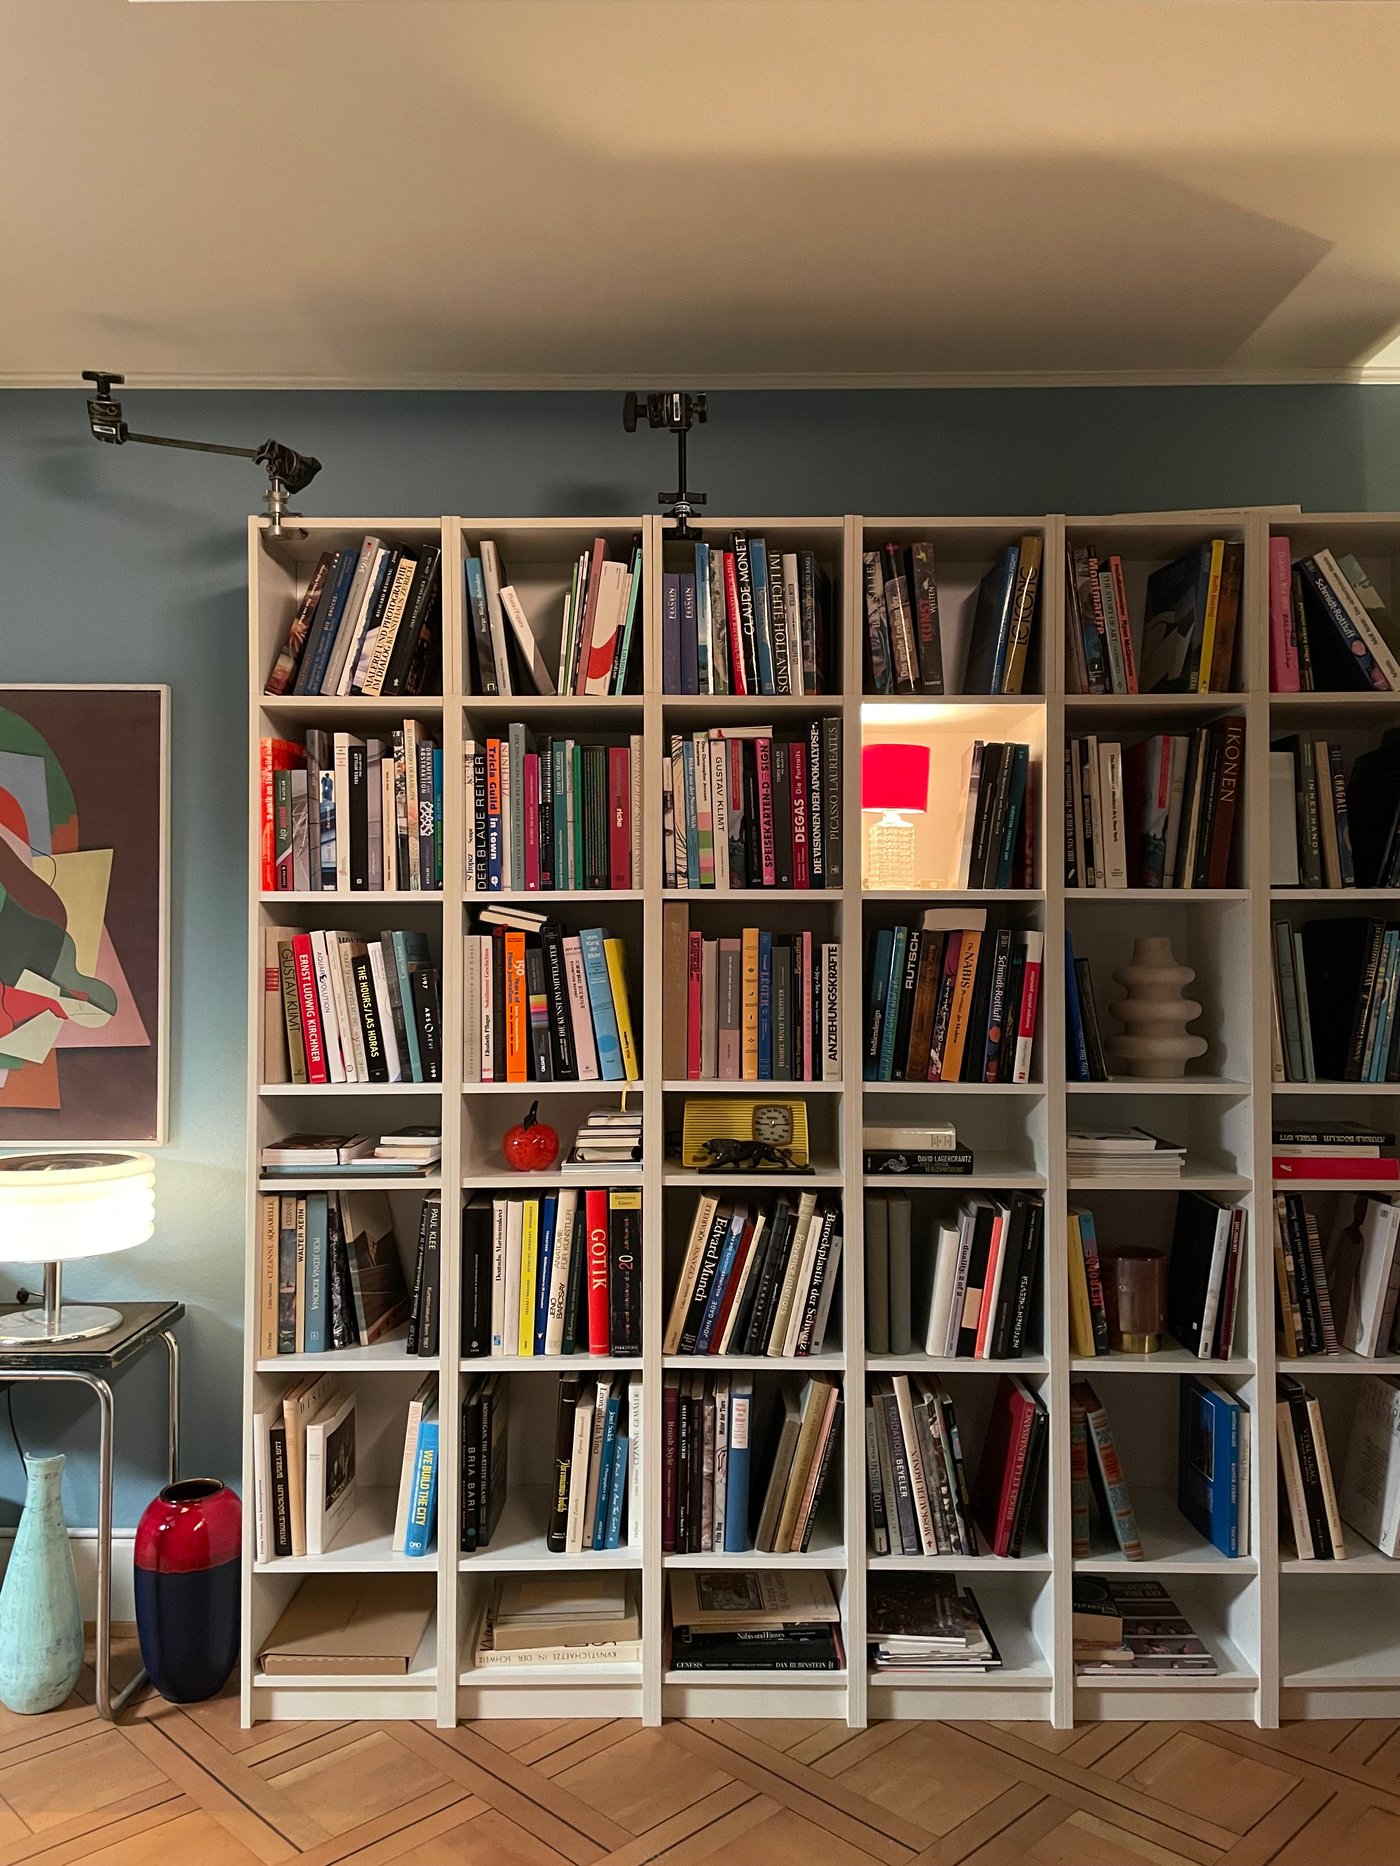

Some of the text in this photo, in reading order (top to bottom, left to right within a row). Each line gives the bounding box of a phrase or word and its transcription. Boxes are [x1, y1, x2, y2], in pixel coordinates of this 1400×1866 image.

[735, 536, 754, 635] CLAUDE MONET
[891, 595, 900, 608] der
[928, 586, 936, 613] WELTEN
[1088, 558, 1106, 634] Montmartre
[1103, 576, 1118, 642] THE STORY OF ART
[1208, 575, 1219, 618] Keith Haring
[1315, 578, 1355, 638] Schmidt-Rottluff
[365, 564, 407, 688] MALEREI UND PHOTOGRAPHIE
[384, 598, 404, 645] KUNSTHAUS
[770, 554, 788, 693] IM LICHTE HOLLANDS
[893, 609, 904, 638] Lexikon
[920, 599, 932, 641] KUNST
[372, 678, 383, 690] IM
[375, 646, 392, 677] DIALOG
[898, 663, 908, 676] Das
[488, 747, 496, 778] Tricia
[501, 745, 509, 797] ZEICHNEN
[828, 727, 839, 840] PICASSO LAUREATUS
[1220, 727, 1241, 803] IKONEN
[489, 782, 497, 810] Guild
[811, 729, 822, 874] DIE VISIONEN DER APOKALYPSE
[1334, 774, 1347, 814] CHAGALL
[475, 756, 487, 889] DER BLAUE REITER
[491, 818, 498, 827] in
[794, 799, 805, 843] DEGAS
[512, 960, 525, 976] 150
[794, 936, 802, 974] Beauties
[905, 932, 919, 989] RUTSCH
[960, 951, 975, 988] NABIS
[282, 948, 300, 1032] GUSTAV KLIMT
[299, 954, 320, 1062] ERNST LUDWIG KIRCHNER
[357, 965, 368, 981] THE
[366, 1030, 379, 1058] HORAS
[549, 944, 566, 1037] DIE KUNST IM MITTELALTER
[827, 946, 838, 1061] ANZIEHUNGSKRÄFTE
[993, 955, 1007, 1022] Schmidt-Rottluff
[870, 1009, 882, 1056] Mediendesign
[313, 1237, 321, 1252] POD
[428, 1208, 438, 1250] PAUL KLEE
[554, 1229, 562, 1269] ANATOMIE
[687, 1203, 712, 1279] CEZANNE AQUARELLE
[591, 1228, 606, 1291] GOTIK
[694, 1217, 728, 1302] Edvard Munch
[789, 1233, 805, 1275] Provence
[424, 1287, 432, 1322] Kunstmuseum
[557, 1282, 565, 1319] BARCSAY
[751, 1274, 770, 1338] EDY BRUNNER
[799, 1214, 835, 1351] Barockplastik der Schweiz
[957, 1282, 964, 1291] of
[703, 1300, 718, 1338] JOHN GAGE
[593, 1387, 607, 1455] Leonardo da Vinci
[607, 1410, 616, 1442] Josef Sudek
[632, 1391, 640, 1428] GEMÄLDE
[666, 1421, 675, 1466] British Style
[888, 1406, 908, 1498] FONDATION BEYELER
[1006, 1406, 1034, 1520] BRUGES ET LA RENAISSANCE
[416, 1450, 433, 1526] WE BUILD THE CITY
[870, 1461, 883, 1514] INSIDE OUT
[917, 1486, 932, 1537] MOSKAUER
